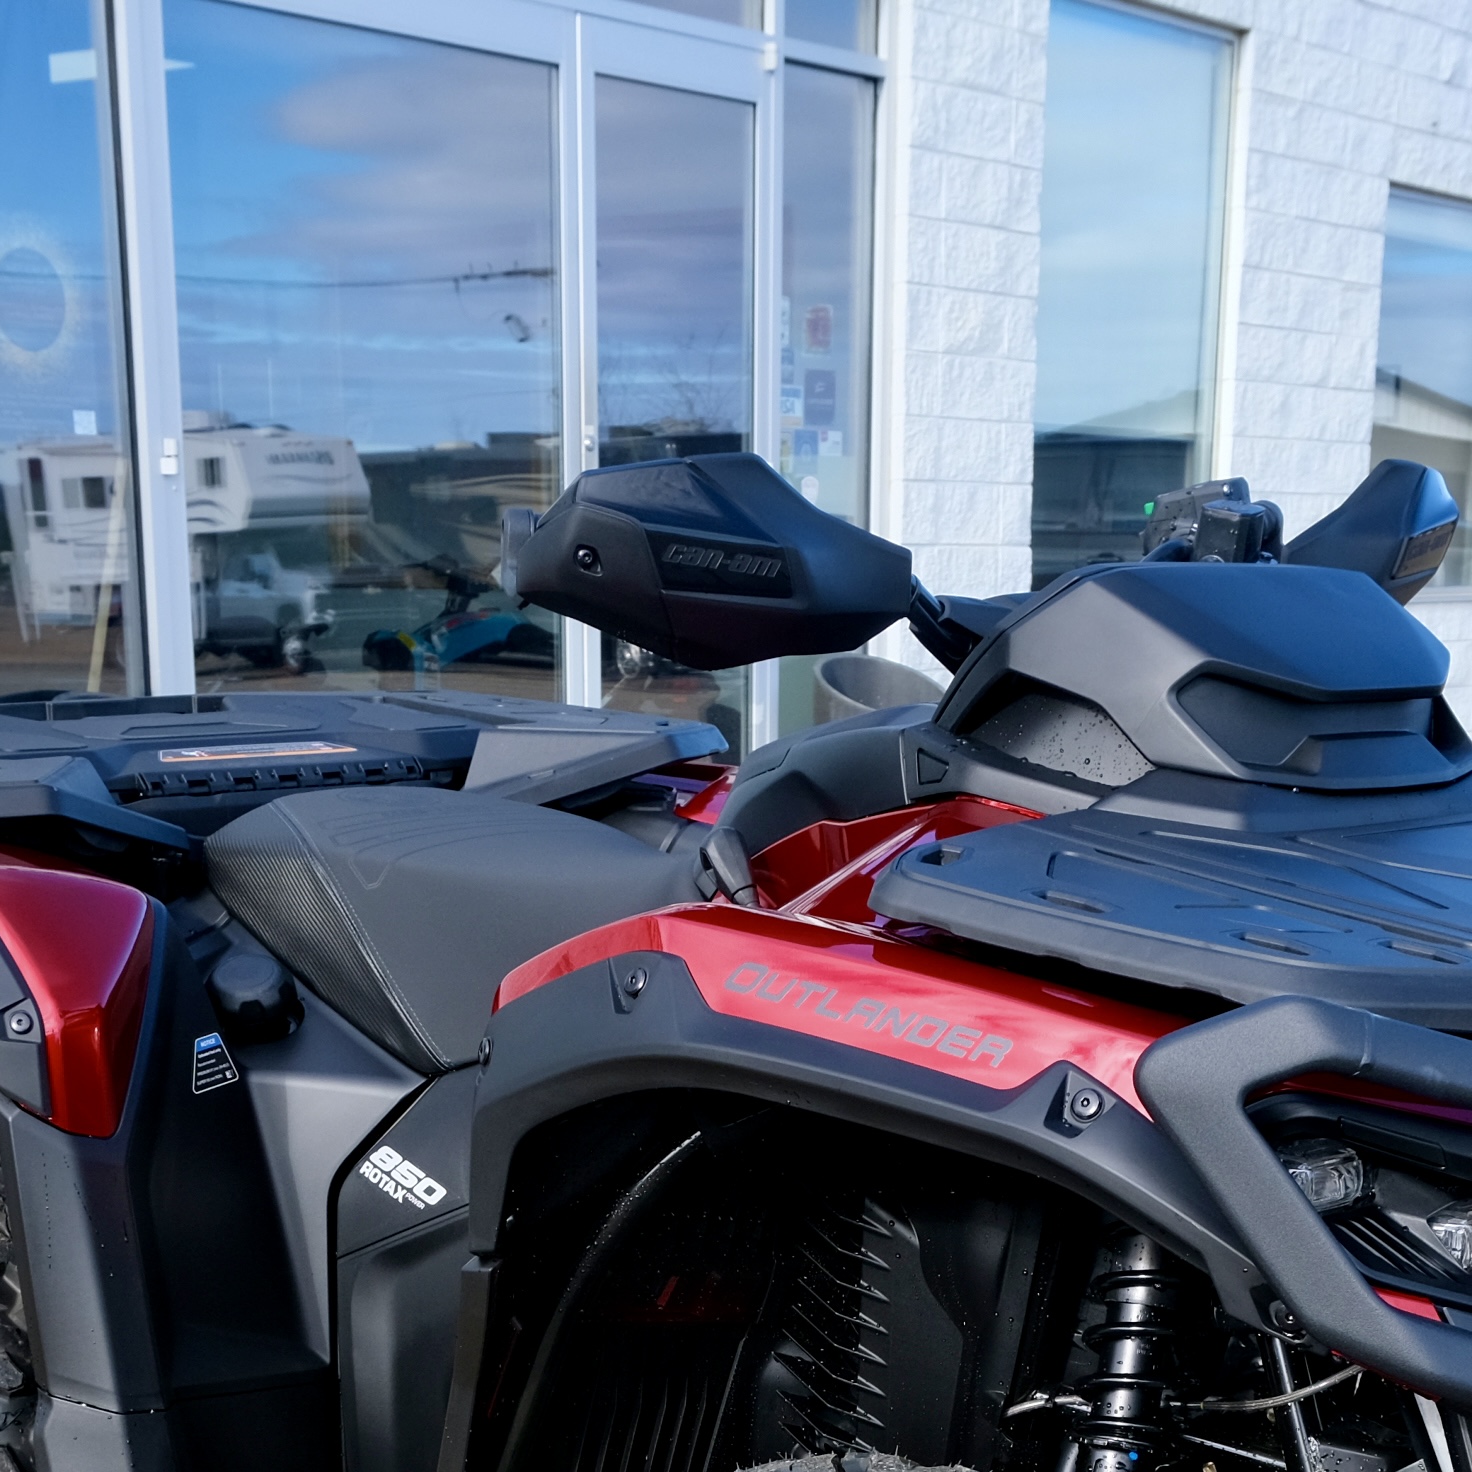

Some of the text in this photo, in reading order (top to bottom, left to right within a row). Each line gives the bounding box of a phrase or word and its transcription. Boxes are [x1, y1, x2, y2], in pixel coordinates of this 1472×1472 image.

[662, 543, 782, 578] can-am
[724, 961, 1014, 1068] OUTLANDER
[359, 1160, 426, 1210] ROTAX POWER
[369, 1145, 447, 1206] 850
